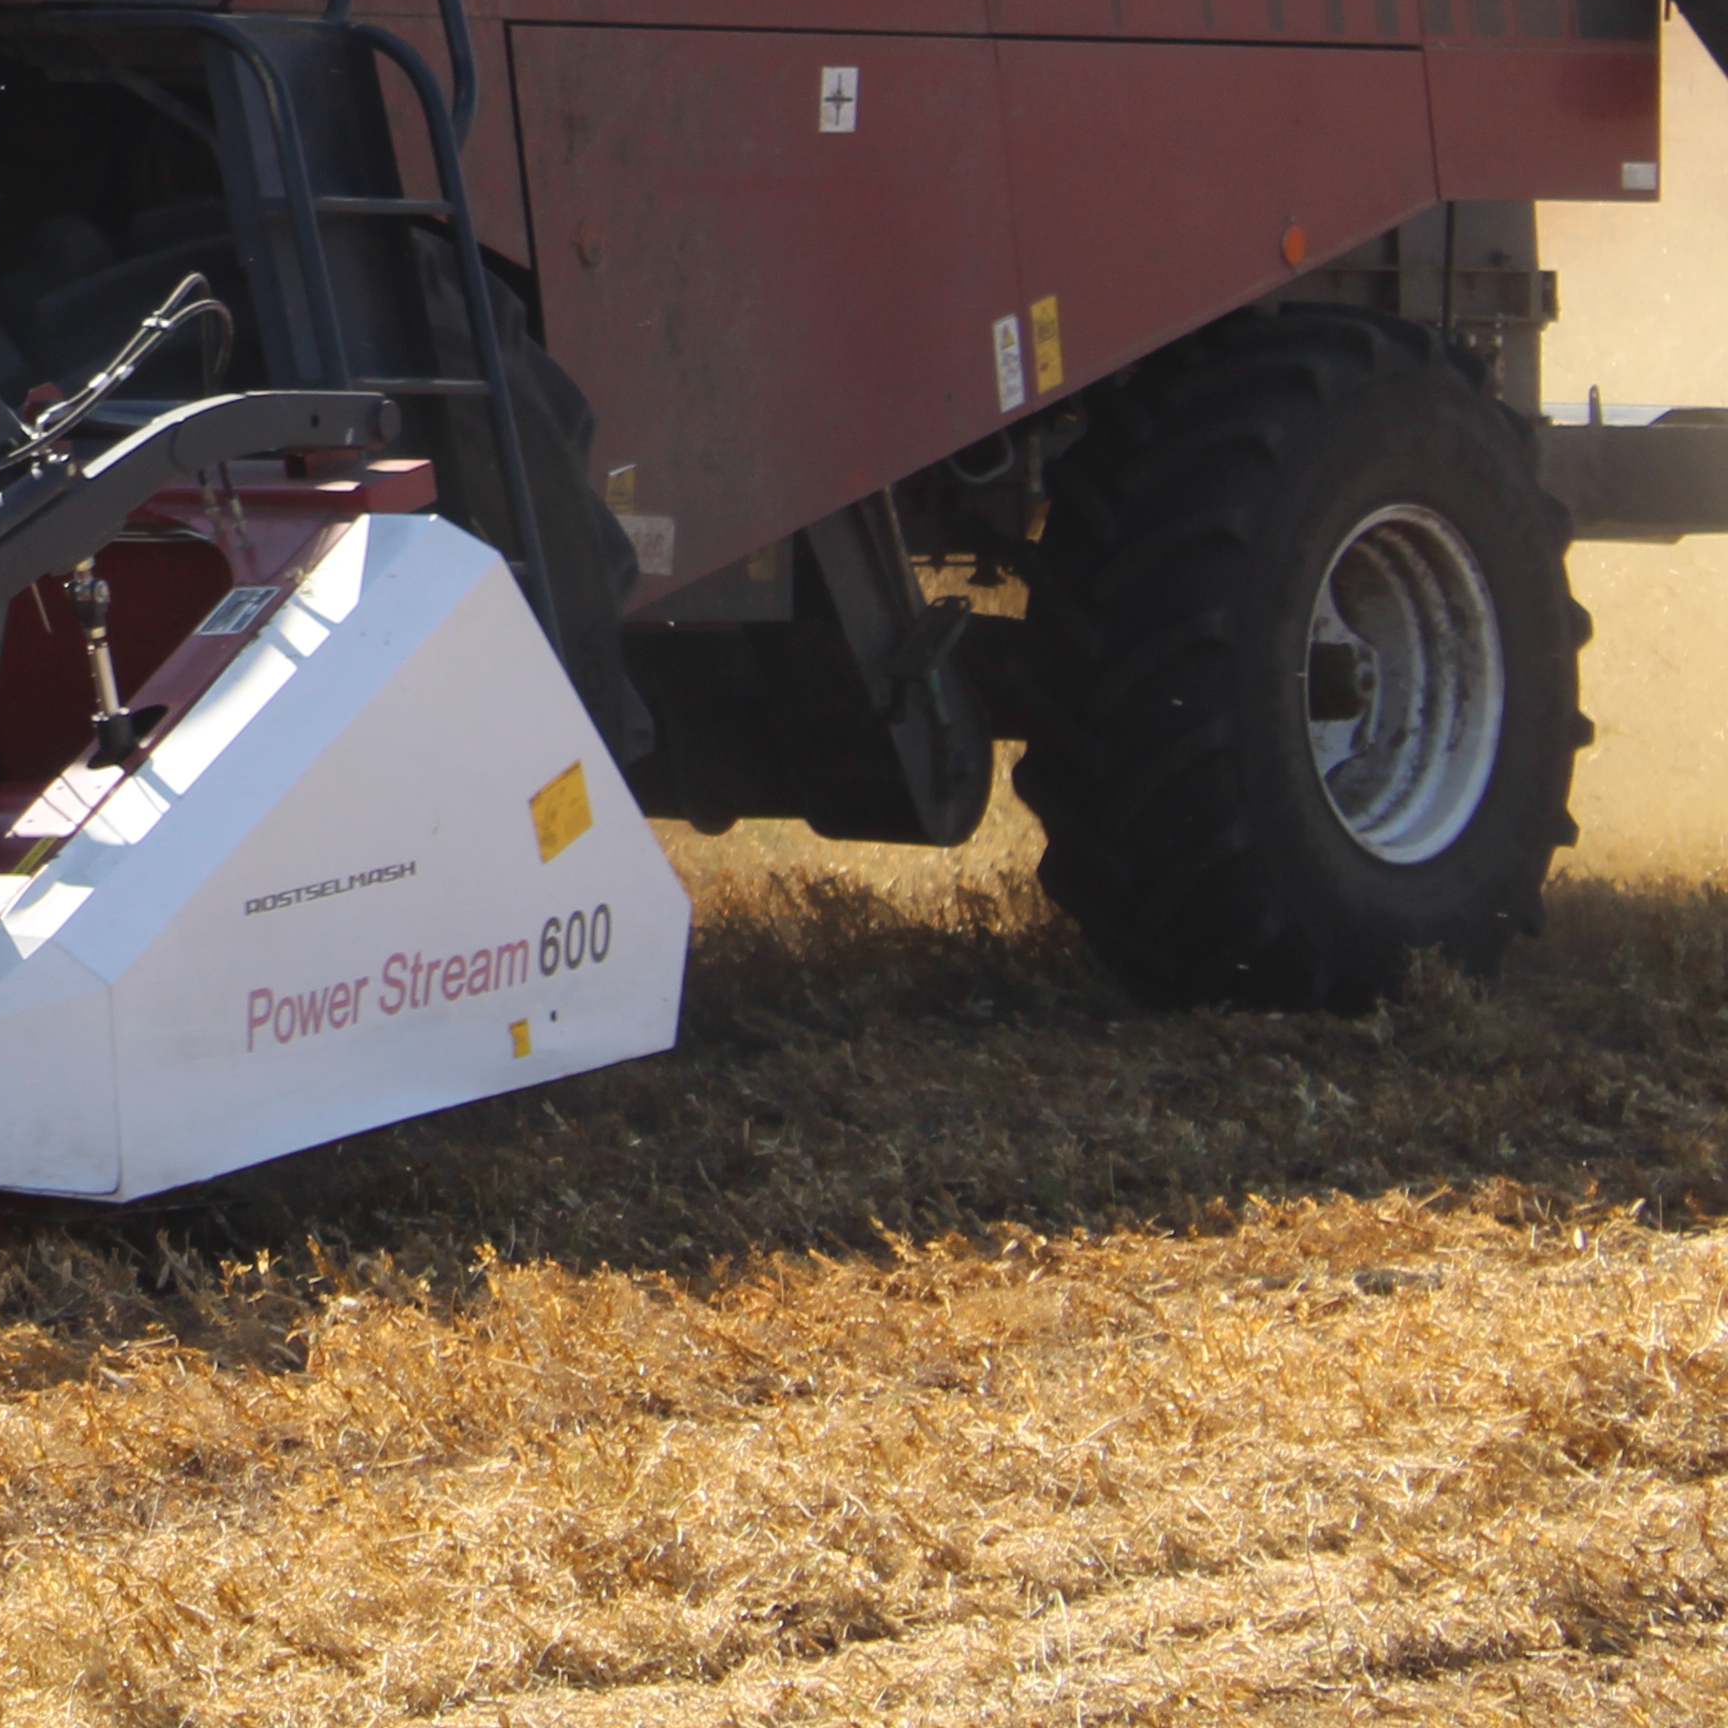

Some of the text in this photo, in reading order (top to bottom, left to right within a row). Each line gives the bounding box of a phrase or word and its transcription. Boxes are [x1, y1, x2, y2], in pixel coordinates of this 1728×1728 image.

[245, 860, 417, 916] ROSTSELMASH
[247, 903, 611, 1053] Power Stream 600
